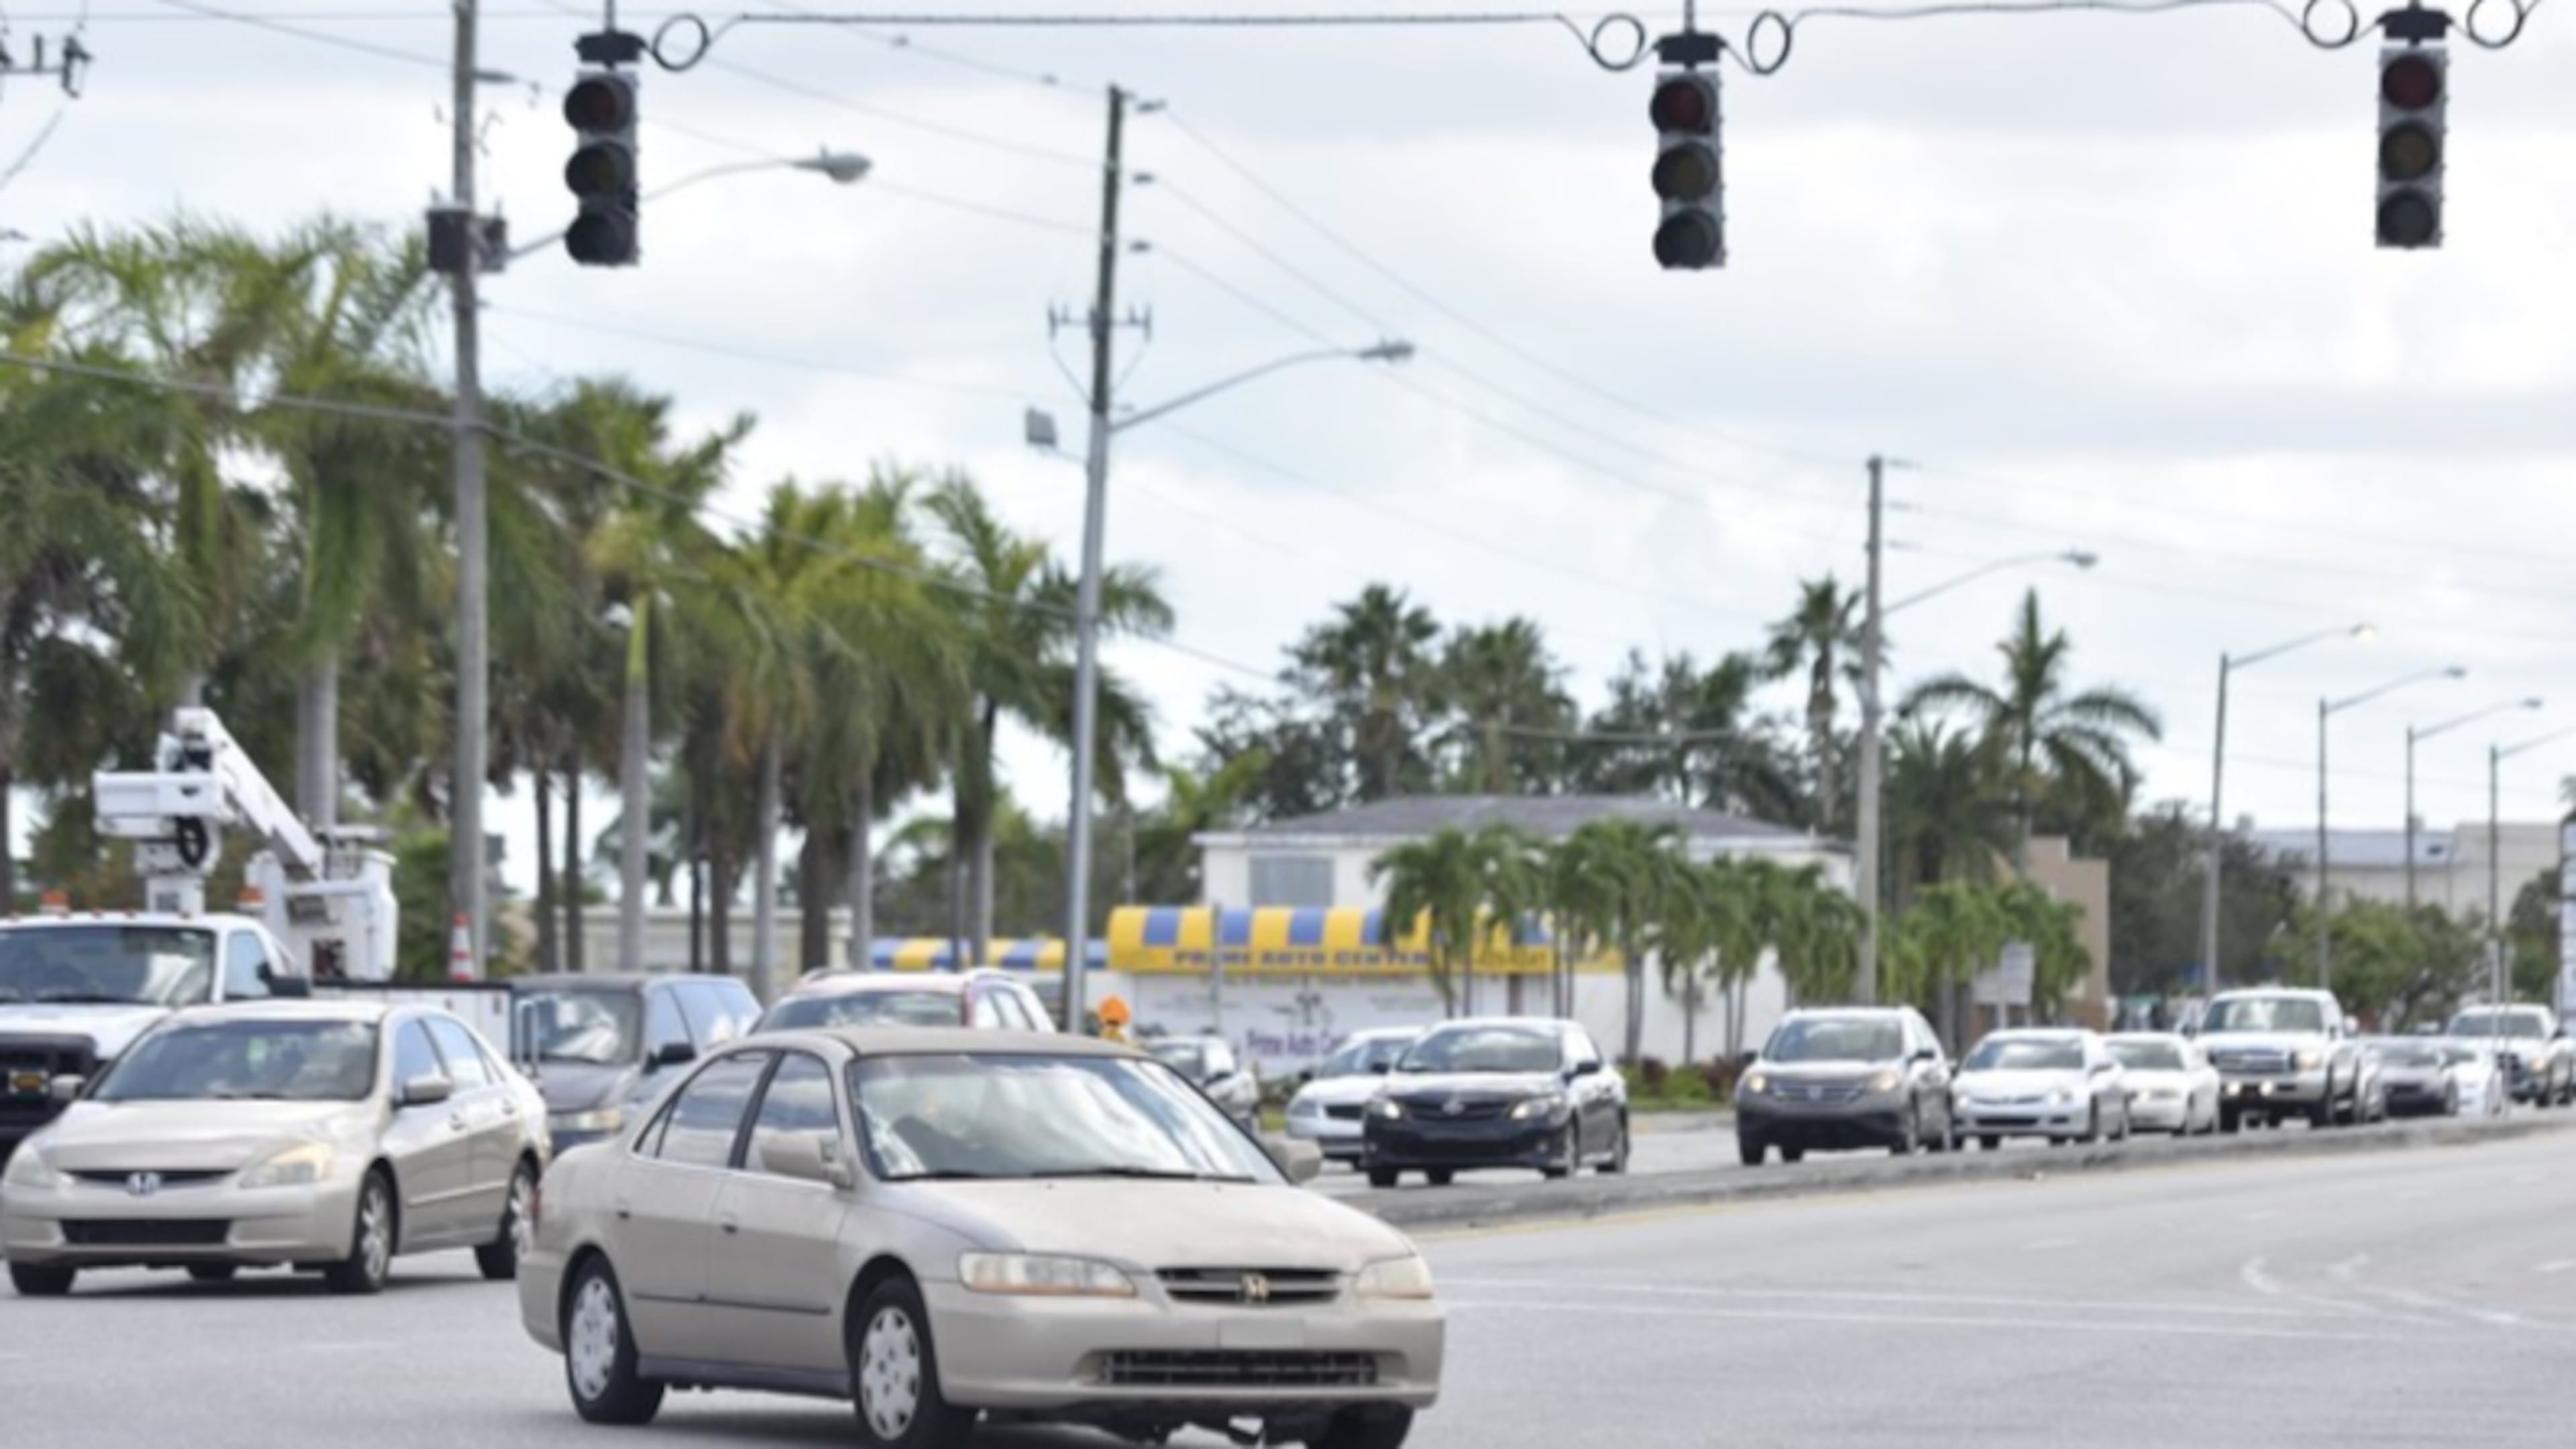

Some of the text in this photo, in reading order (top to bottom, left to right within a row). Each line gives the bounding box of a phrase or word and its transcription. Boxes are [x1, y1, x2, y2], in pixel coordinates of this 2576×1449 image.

[1173, 951, 1251, 965] PRME
[1260, 951, 1324, 965] AUTO
[1287, 1031, 1316, 1056] Auto
